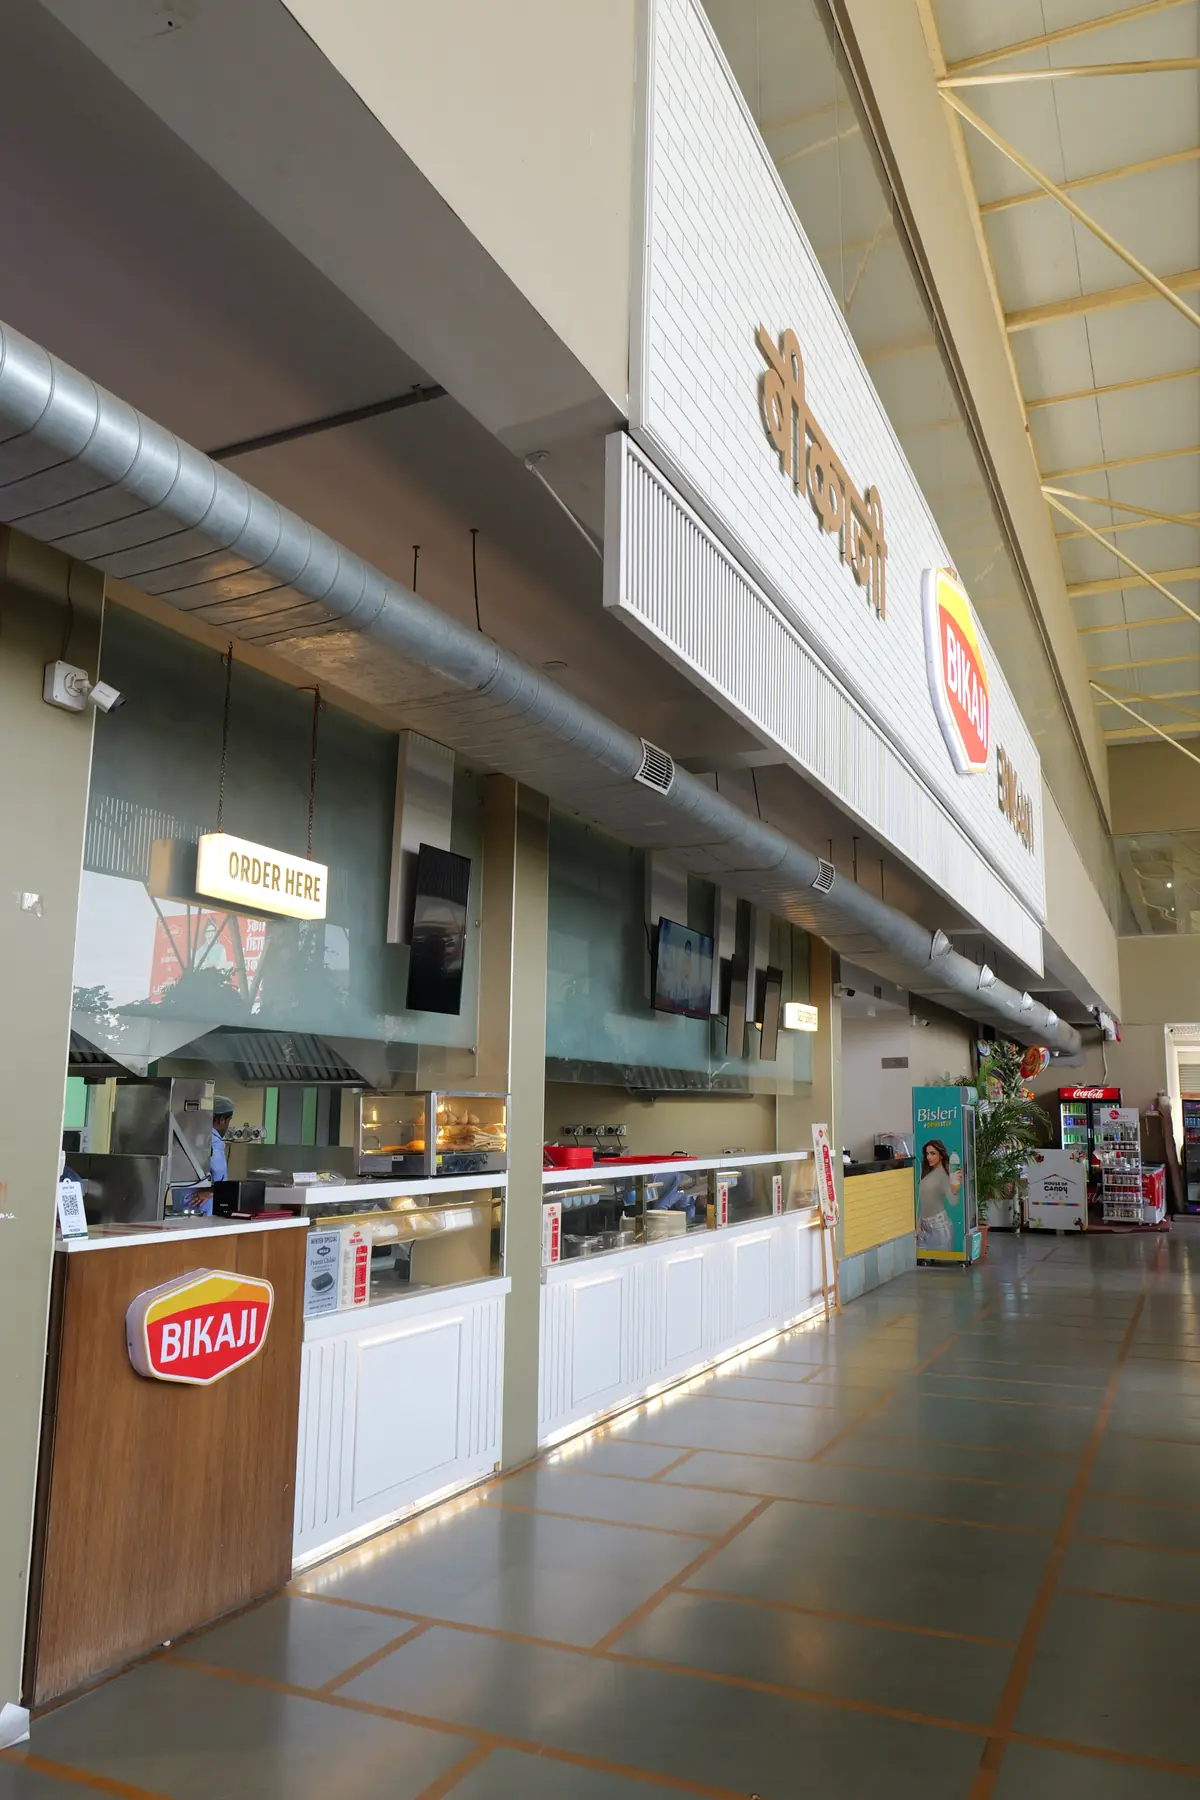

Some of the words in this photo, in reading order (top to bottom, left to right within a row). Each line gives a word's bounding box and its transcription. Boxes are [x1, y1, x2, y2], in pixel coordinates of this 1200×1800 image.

[759, 321, 887, 622] बीकाजी
[946, 622, 987, 750] BIKAJI
[228, 851, 281, 892] ORDER
[285, 867, 321, 902] HERE
[917, 1106, 957, 1122] Bisleri
[160, 1308, 257, 1363] BIKAJI
